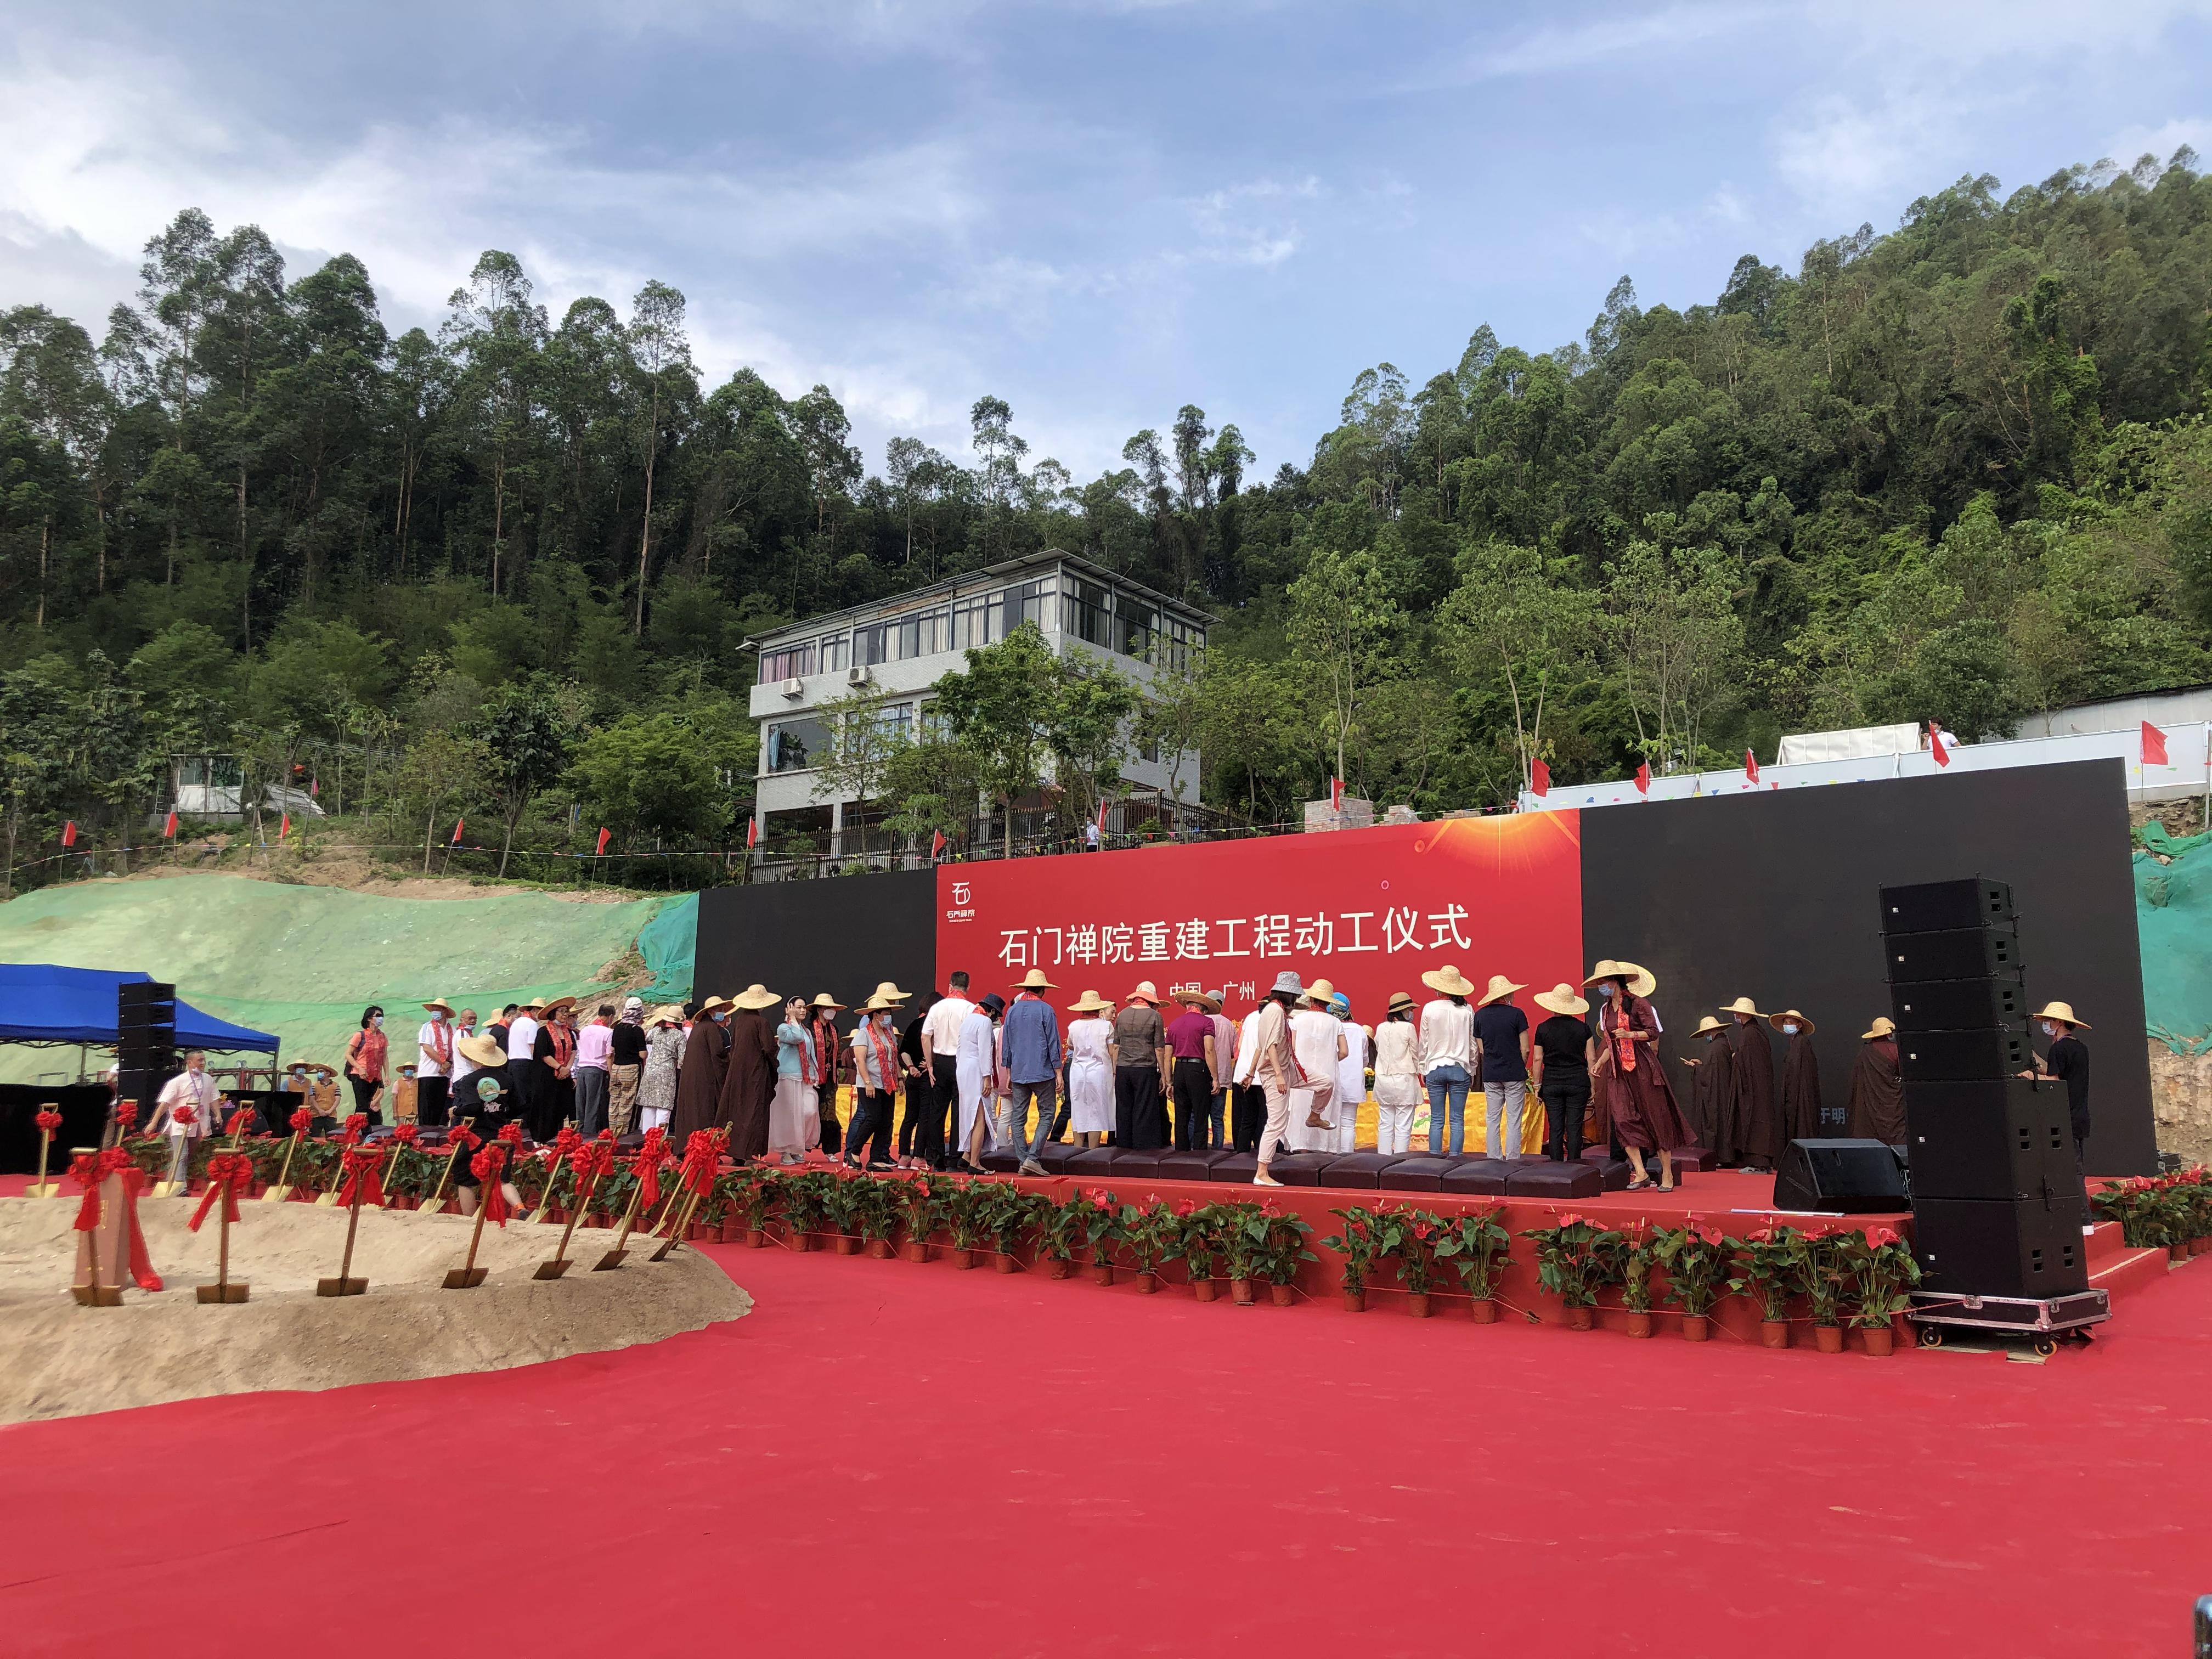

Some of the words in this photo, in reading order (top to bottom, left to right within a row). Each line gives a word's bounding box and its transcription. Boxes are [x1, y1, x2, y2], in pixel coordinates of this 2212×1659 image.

[998, 903, 1471, 968] 石门禅院重建工程动工仪式
[1223, 980, 1255, 1001] 广州
[1820, 1107, 1848, 1125] 于明
